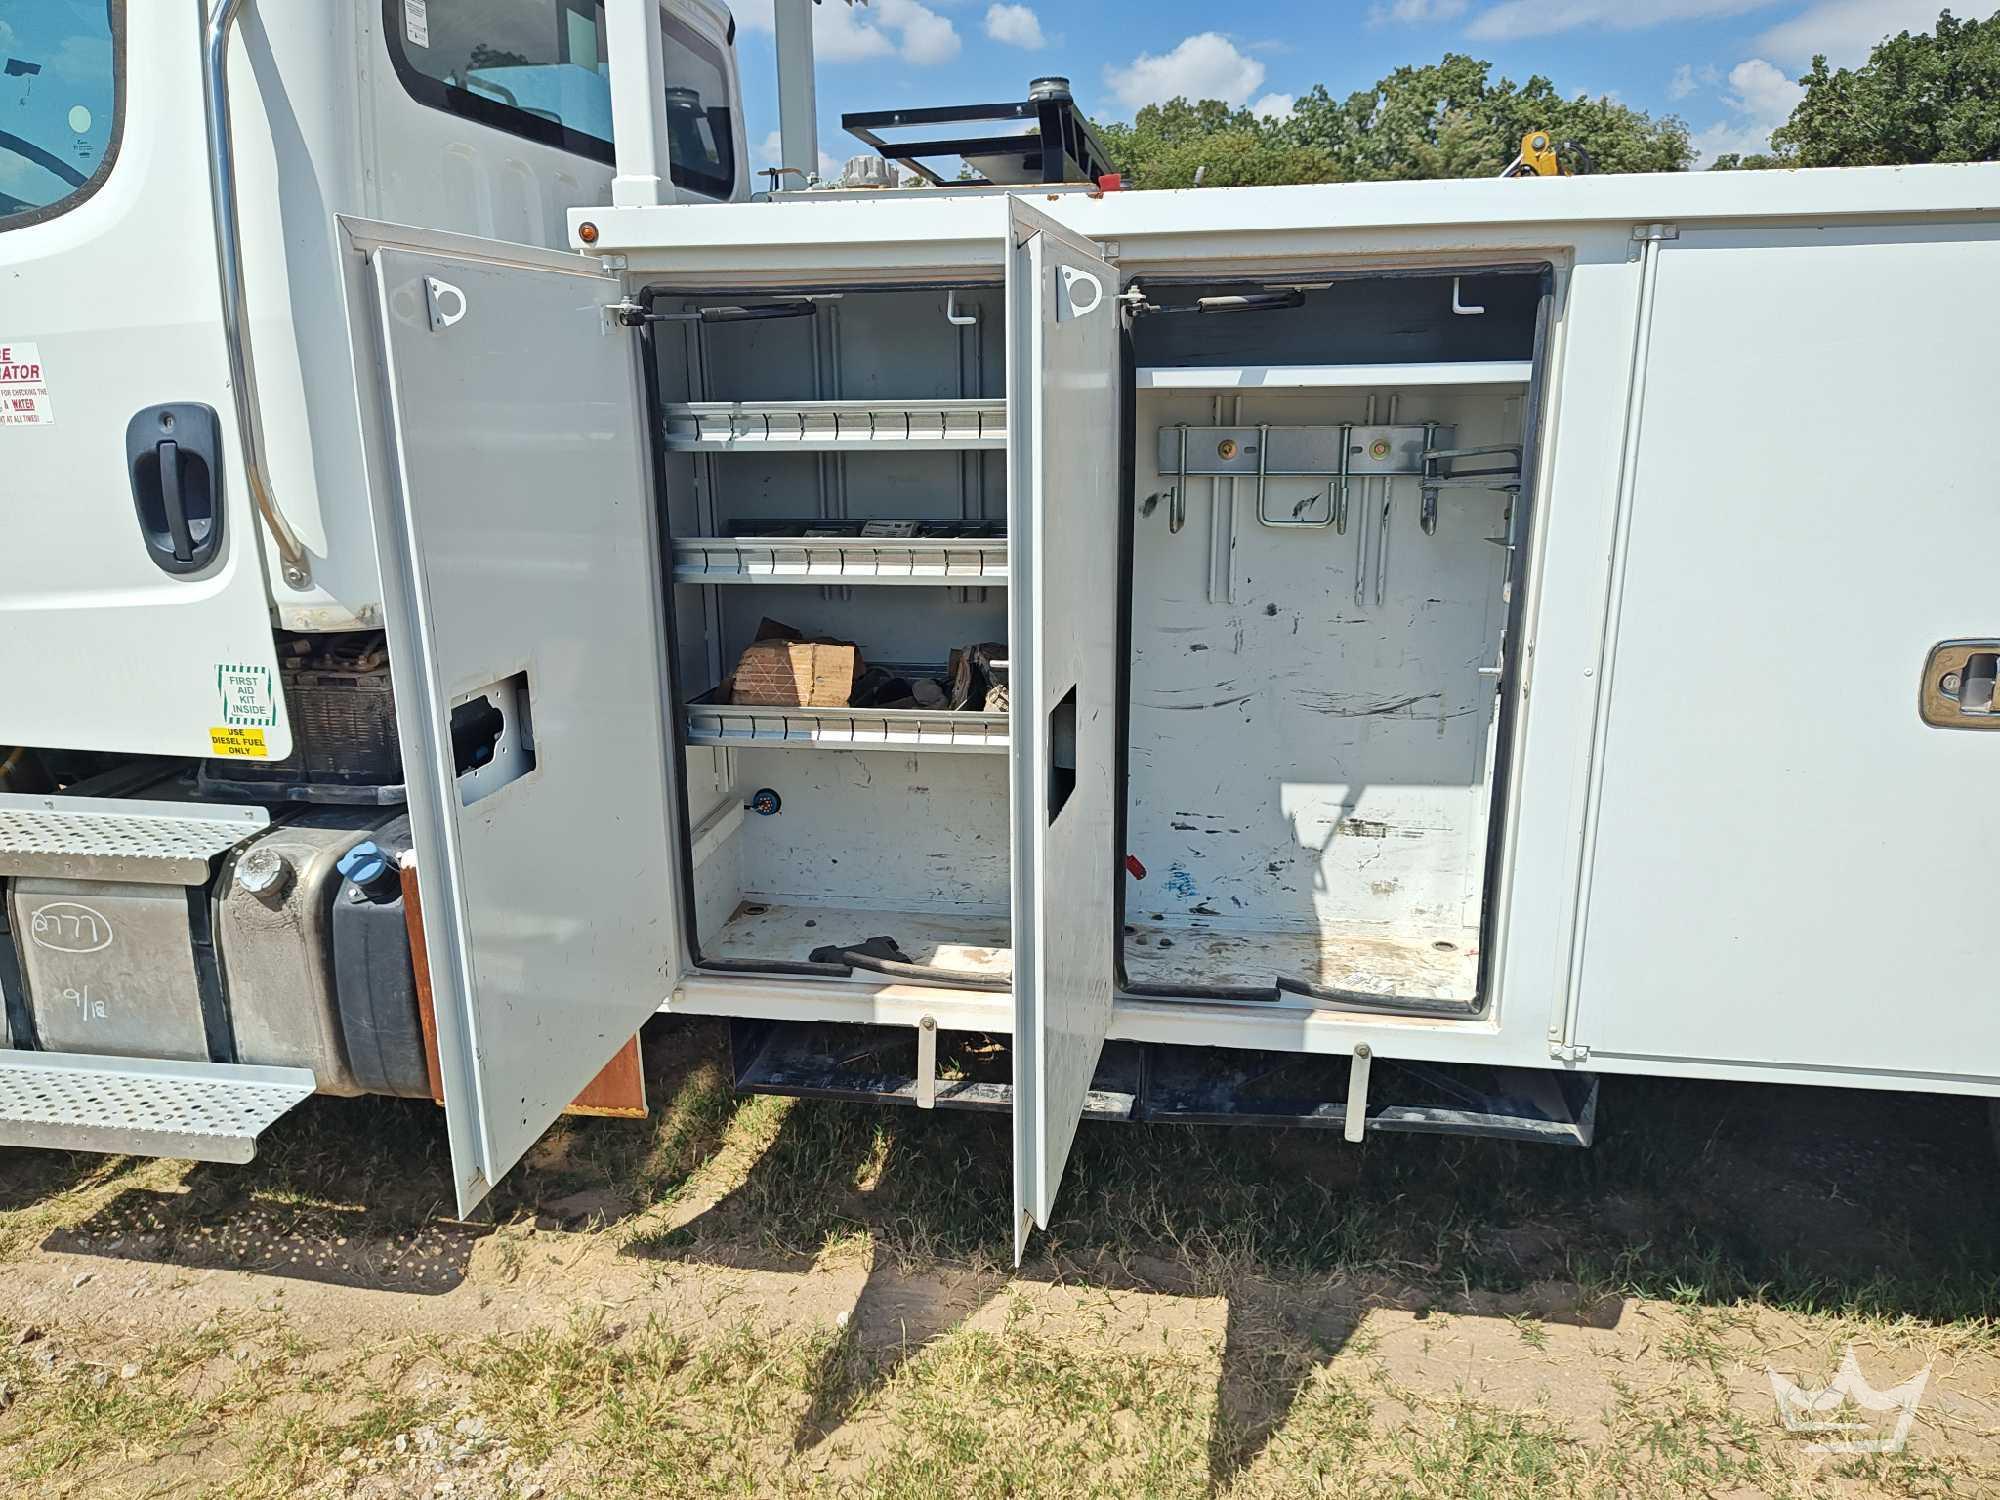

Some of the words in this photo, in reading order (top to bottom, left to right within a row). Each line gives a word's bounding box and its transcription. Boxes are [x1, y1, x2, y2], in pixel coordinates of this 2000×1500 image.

[0, 365, 40, 379] ATOR
[12, 399, 35, 409] WATER
[229, 676, 257, 686] FIRST
[238, 686, 255, 695] AID
[240, 696, 255, 704] KIT
[233, 705, 267, 715] INSIDE
[228, 728, 245, 736] USE
[212, 736, 240, 745] DIESEL
[243, 738, 265, 747] FUEL
[228, 746, 250, 755] ONLY
